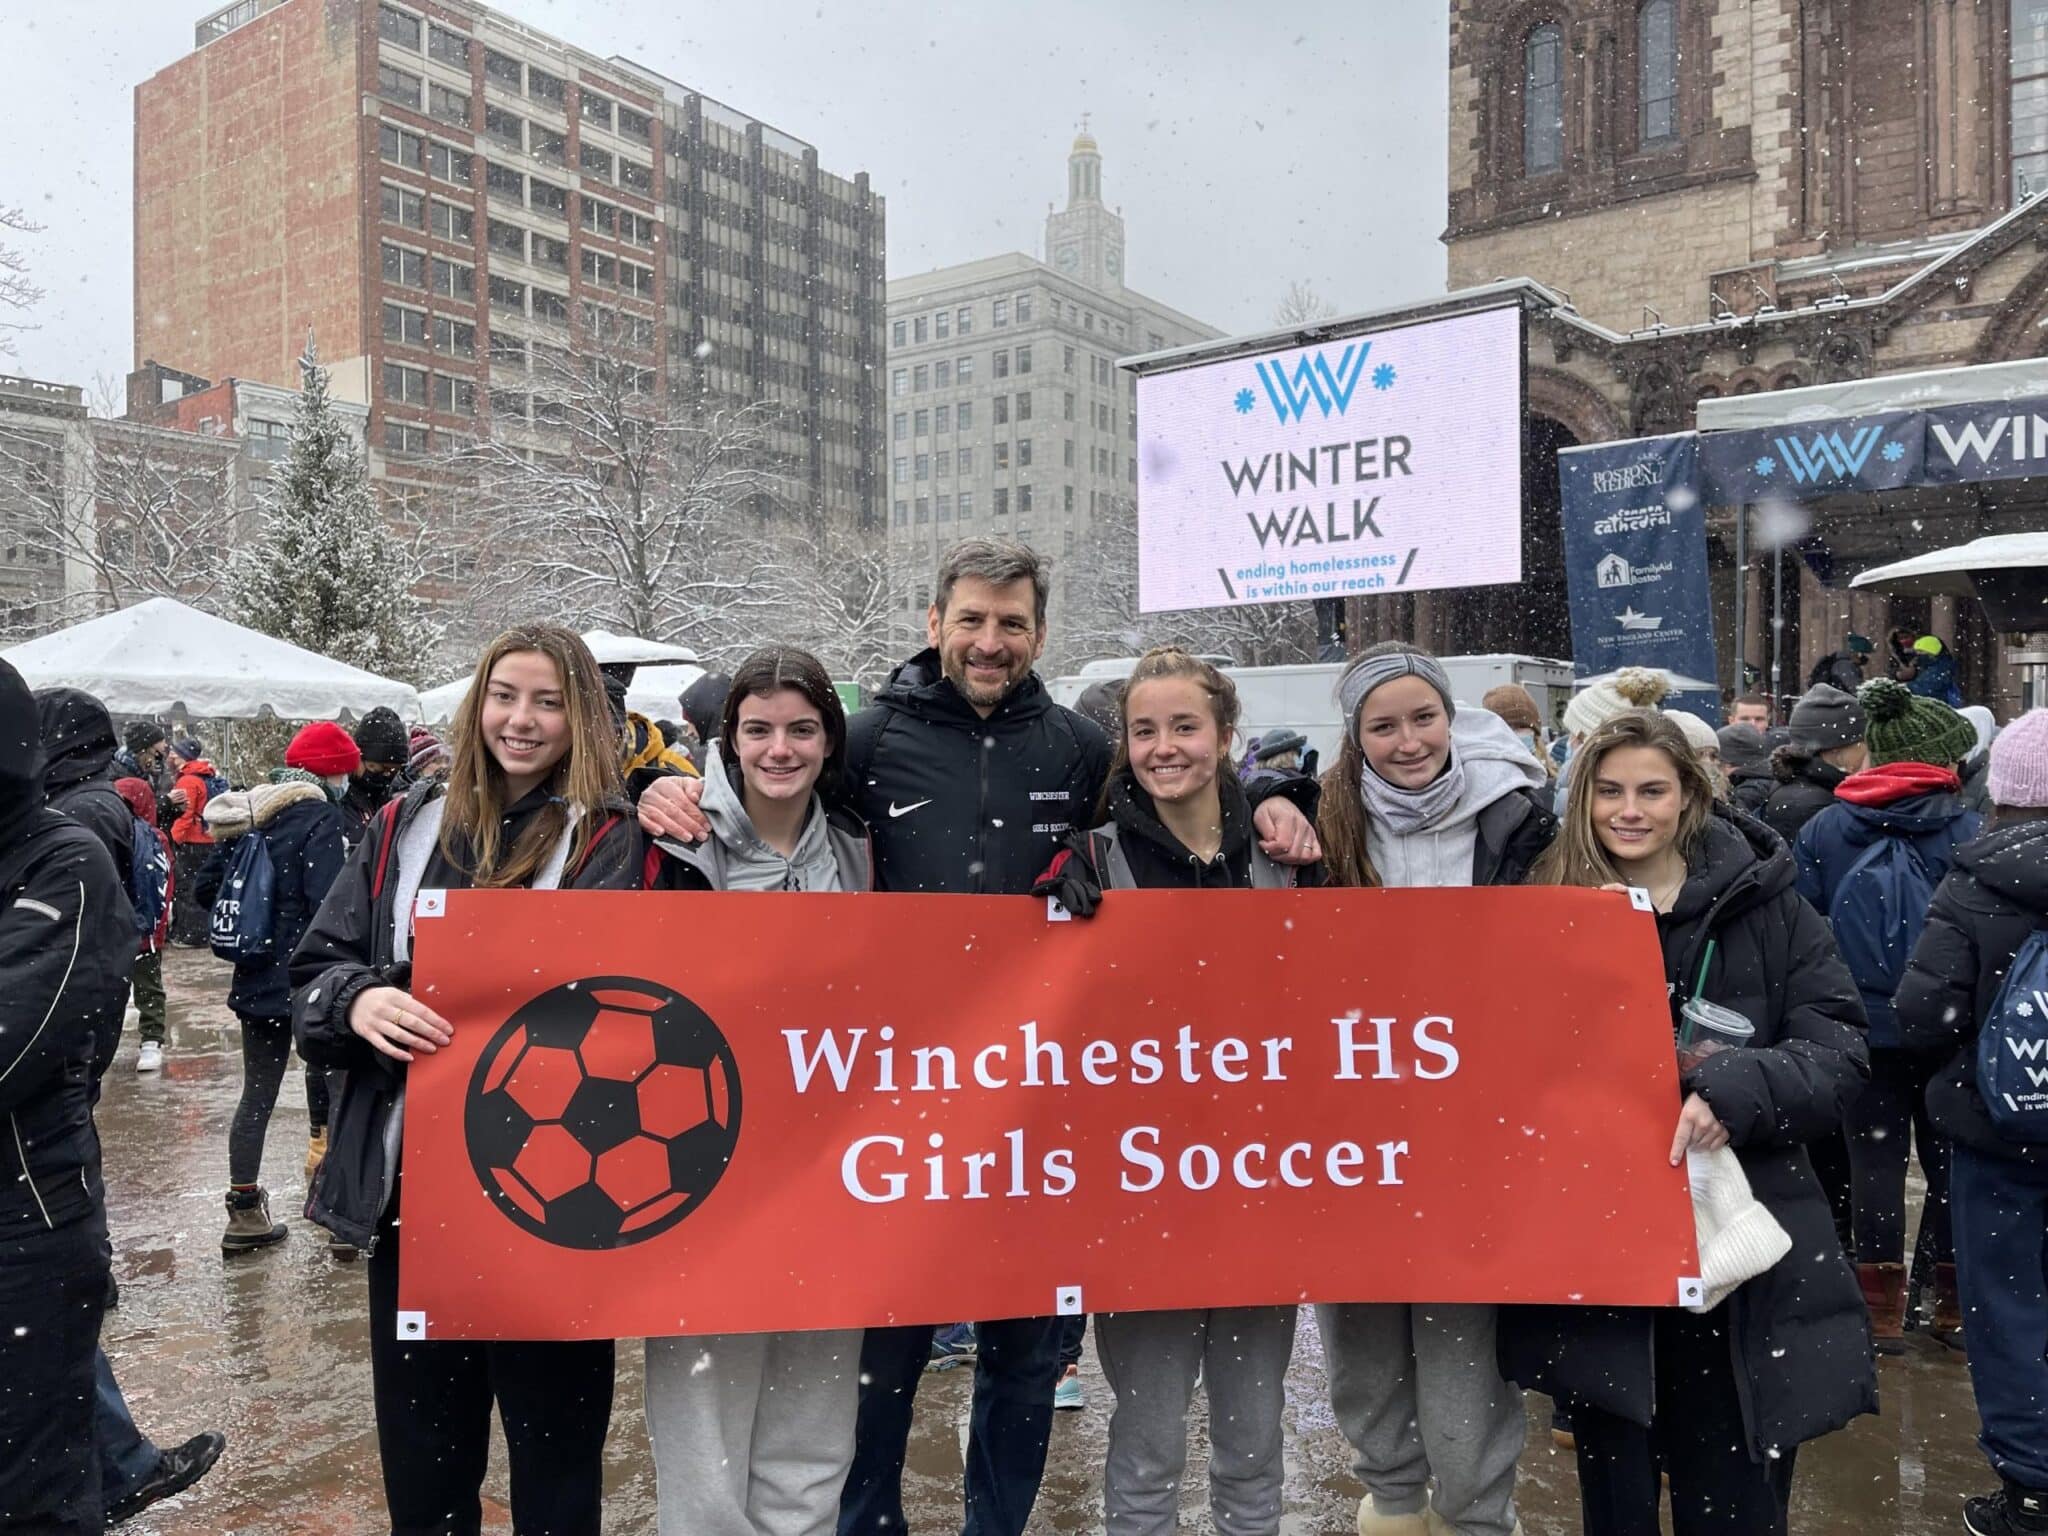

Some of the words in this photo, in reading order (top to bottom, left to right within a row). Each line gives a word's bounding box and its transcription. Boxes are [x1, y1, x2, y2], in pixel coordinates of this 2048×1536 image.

[1220, 435, 1413, 497] WINTER
[1593, 463, 1653, 483] BOSTON
[1593, 472, 1663, 494] MEDICAL
[1247, 497, 1384, 550] WALK
[1594, 511, 1671, 535] cathedral
[1236, 560, 1286, 581] ending
[1290, 554, 1397, 576] homelessness
[1246, 585, 1257, 599] is
[1262, 581, 1307, 597] within
[1312, 580, 1336, 594] our
[1342, 573, 1385, 590] reach
[1029, 791, 1070, 801] WINCHESTER
[1032, 823, 1049, 833] GIRLS
[780, 1021, 1293, 1093] Winchester
[1331, 1016, 1461, 1080] HS
[842, 1128, 1077, 1204] Girls
[1120, 1126, 1410, 1193] Soccer
